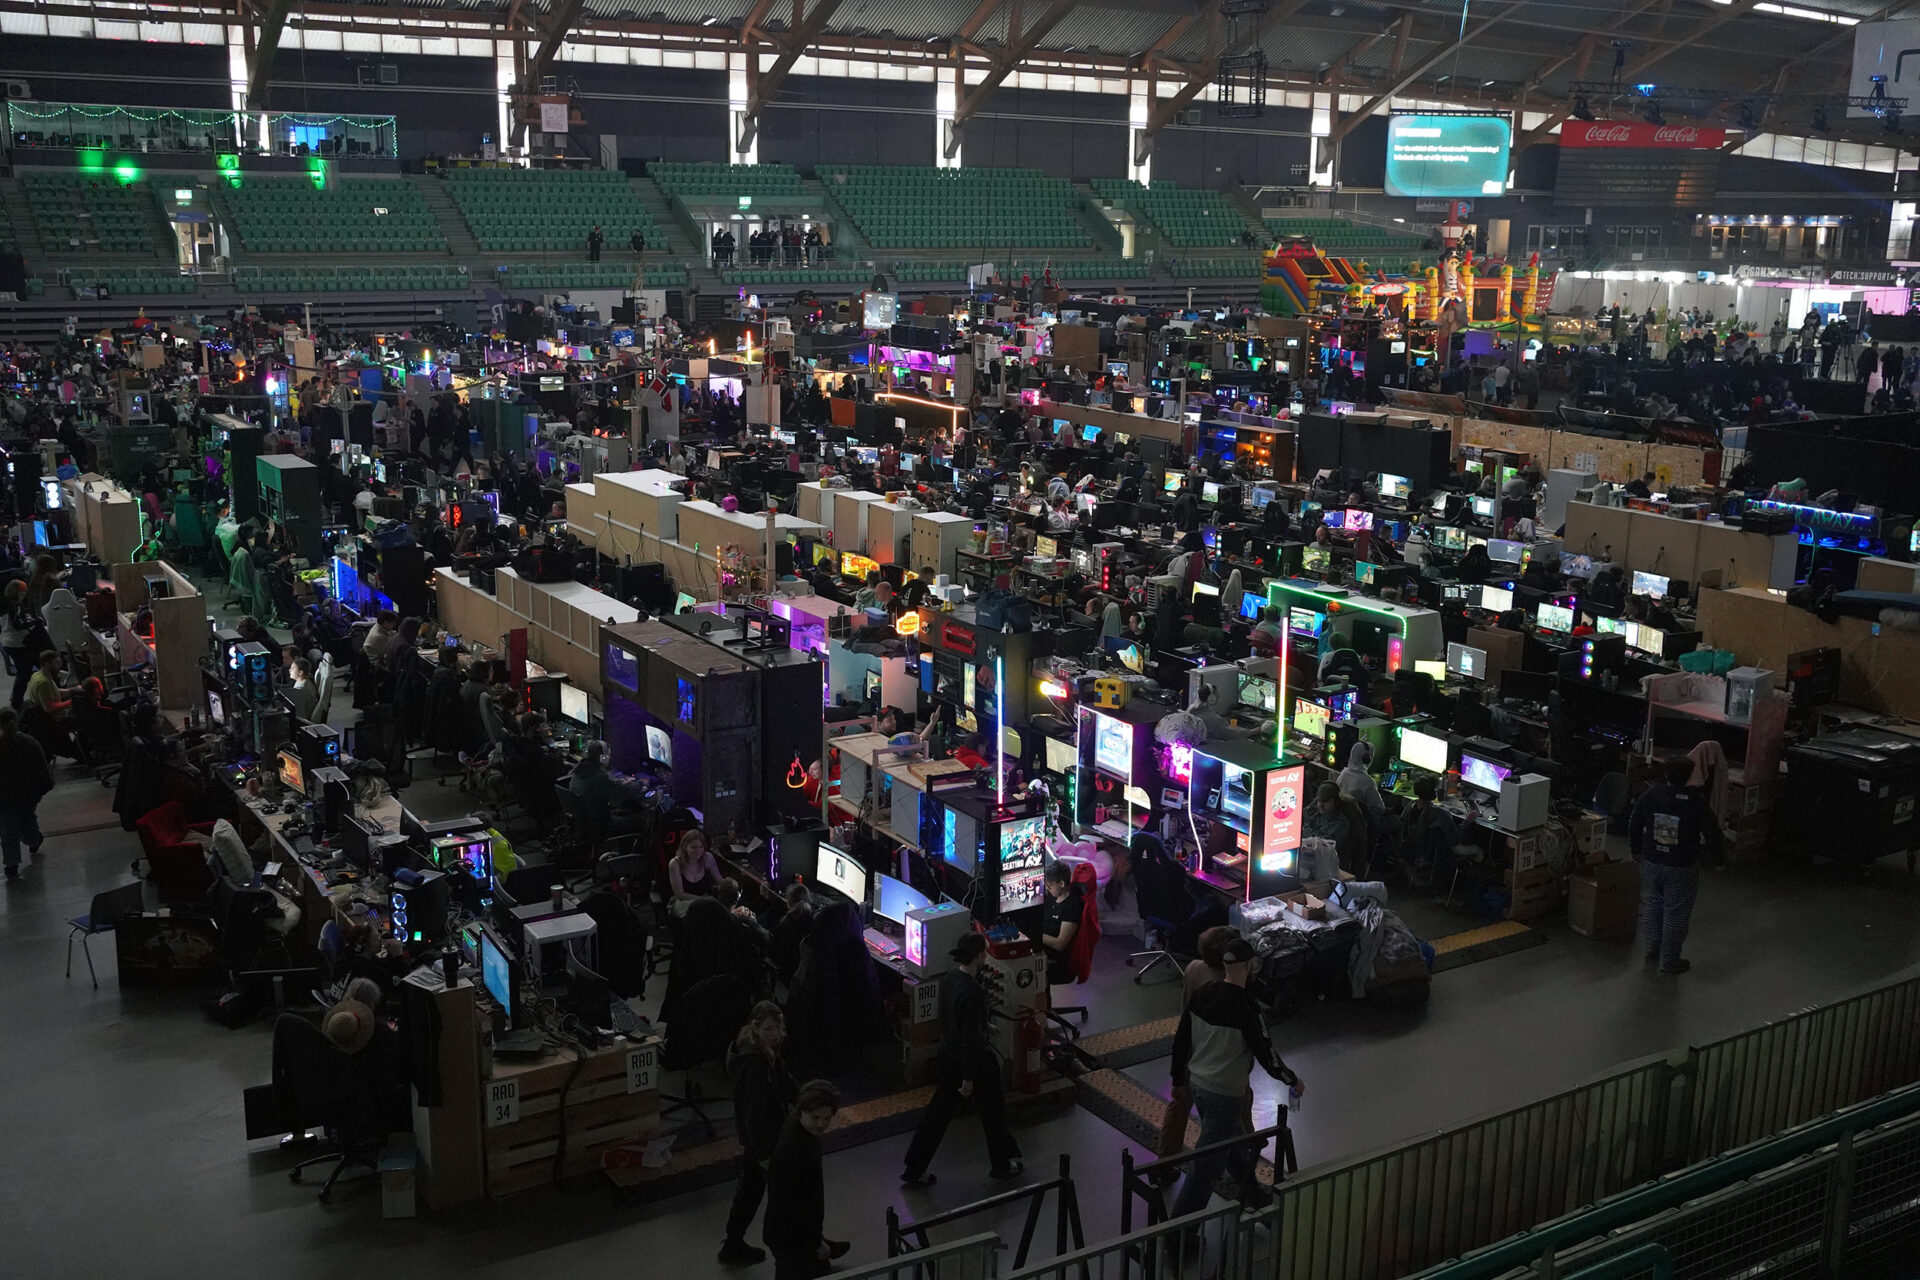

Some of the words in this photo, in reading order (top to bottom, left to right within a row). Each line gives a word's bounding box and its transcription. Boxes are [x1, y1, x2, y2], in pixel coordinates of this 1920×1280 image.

[919, 984, 936, 1001] RAD
[920, 1003, 932, 1018] 32
[631, 1051, 653, 1070] RAD
[635, 1071, 649, 1088] 33
[492, 1083, 515, 1102] RAD
[496, 1104, 511, 1121] 34
